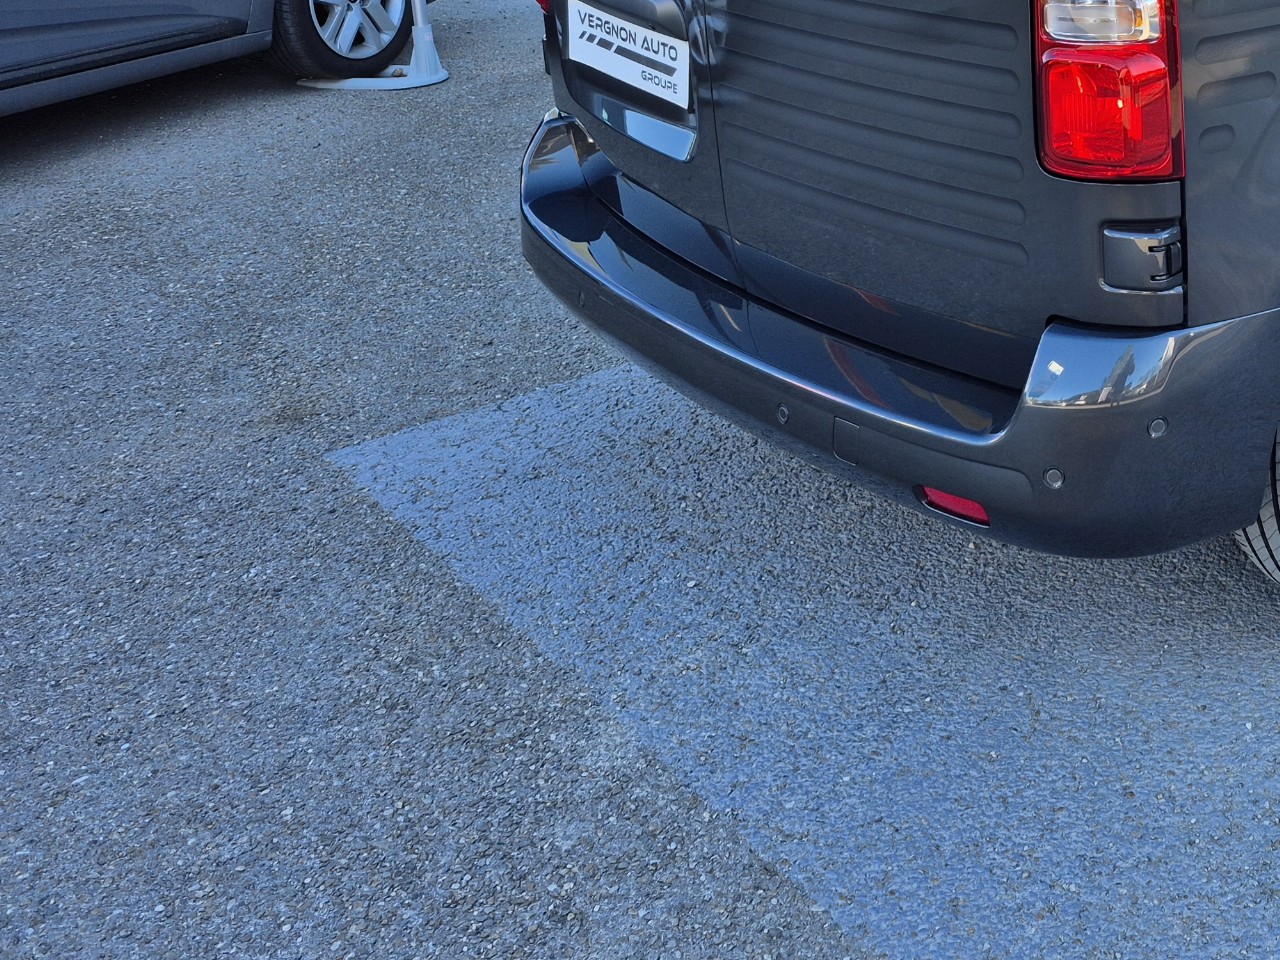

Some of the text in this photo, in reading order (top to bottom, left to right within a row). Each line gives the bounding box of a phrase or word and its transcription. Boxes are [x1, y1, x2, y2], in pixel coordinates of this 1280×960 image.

[577, 9, 678, 62] VERGNON AUTO
[640, 69, 678, 95] GROUPE
